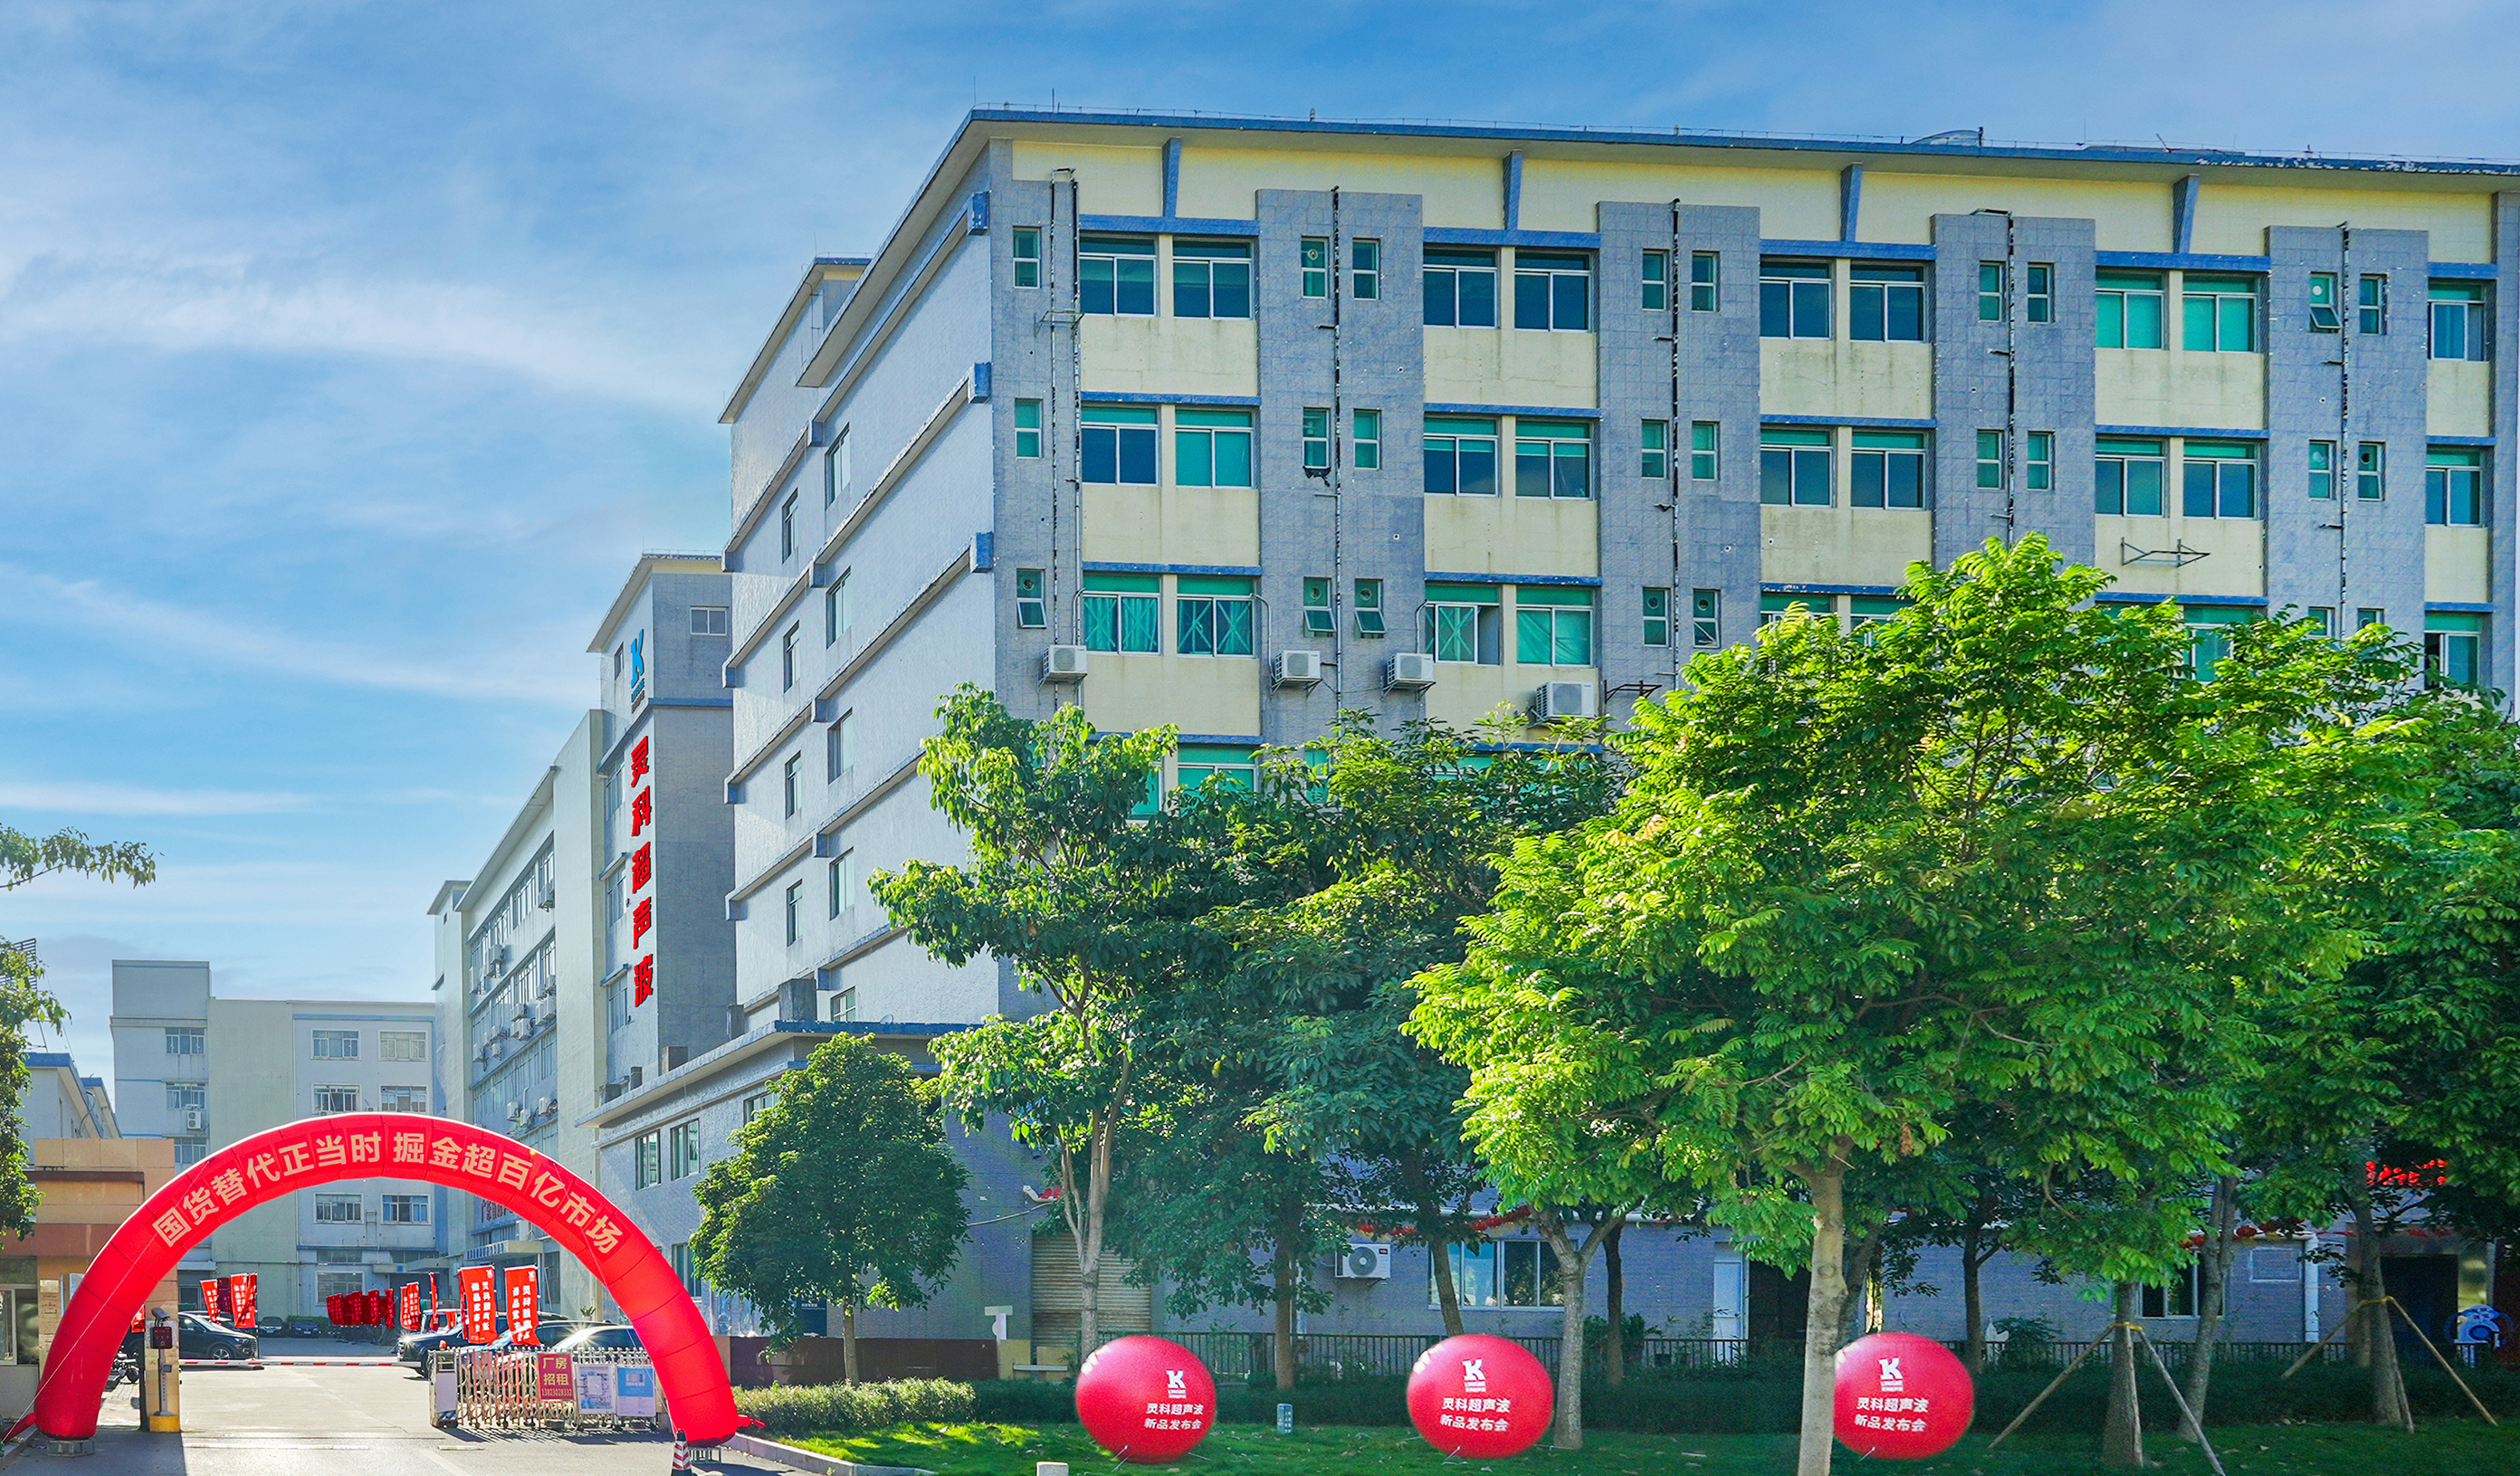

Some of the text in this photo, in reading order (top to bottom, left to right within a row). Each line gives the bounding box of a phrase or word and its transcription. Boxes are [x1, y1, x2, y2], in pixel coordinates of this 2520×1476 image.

[631, 629, 644, 689] K
[631, 736, 654, 1007] 灵科超声波
[152, 1131, 623, 1254] 国货替代正当时 掘金超百亿市场
[543, 1357, 568, 1369] 厂房
[1462, 1358, 1486, 1380] K
[1878, 1357, 1904, 1379] K
[543, 1373, 569, 1386] 招租
[1166, 1370, 1186, 1388] K
[1145, 1403, 1204, 1415] 灵科超声波
[1442, 1397, 1511, 1413] 灵科超声波
[1857, 1397, 1929, 1413] 灵科超声波
[1143, 1418, 1202, 1430] 新品发布会
[1439, 1414, 1510, 1432] 新品发布会
[1854, 1414, 1927, 1432] 新品发布会
